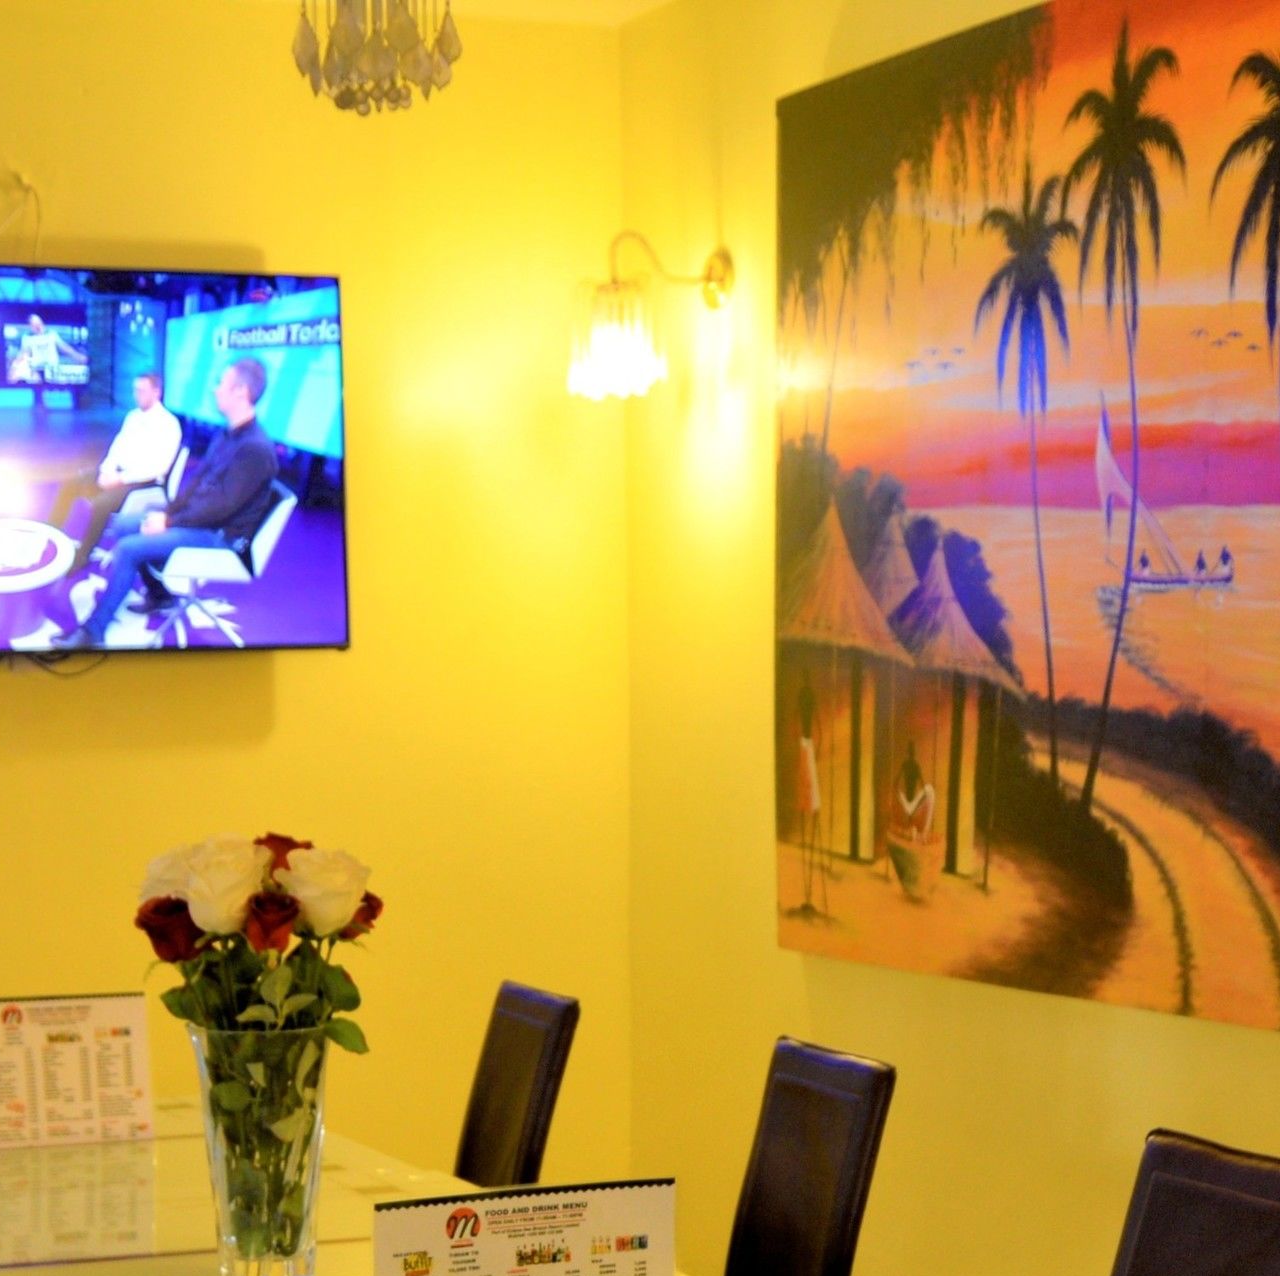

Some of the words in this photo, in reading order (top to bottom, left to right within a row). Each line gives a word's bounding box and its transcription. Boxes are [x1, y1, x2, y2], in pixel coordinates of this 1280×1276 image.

[230, 323, 287, 344] Football
[485, 1209, 509, 1217] FOOD
[532, 1204, 559, 1212] DRINK
[562, 1201, 588, 1209] MENU
